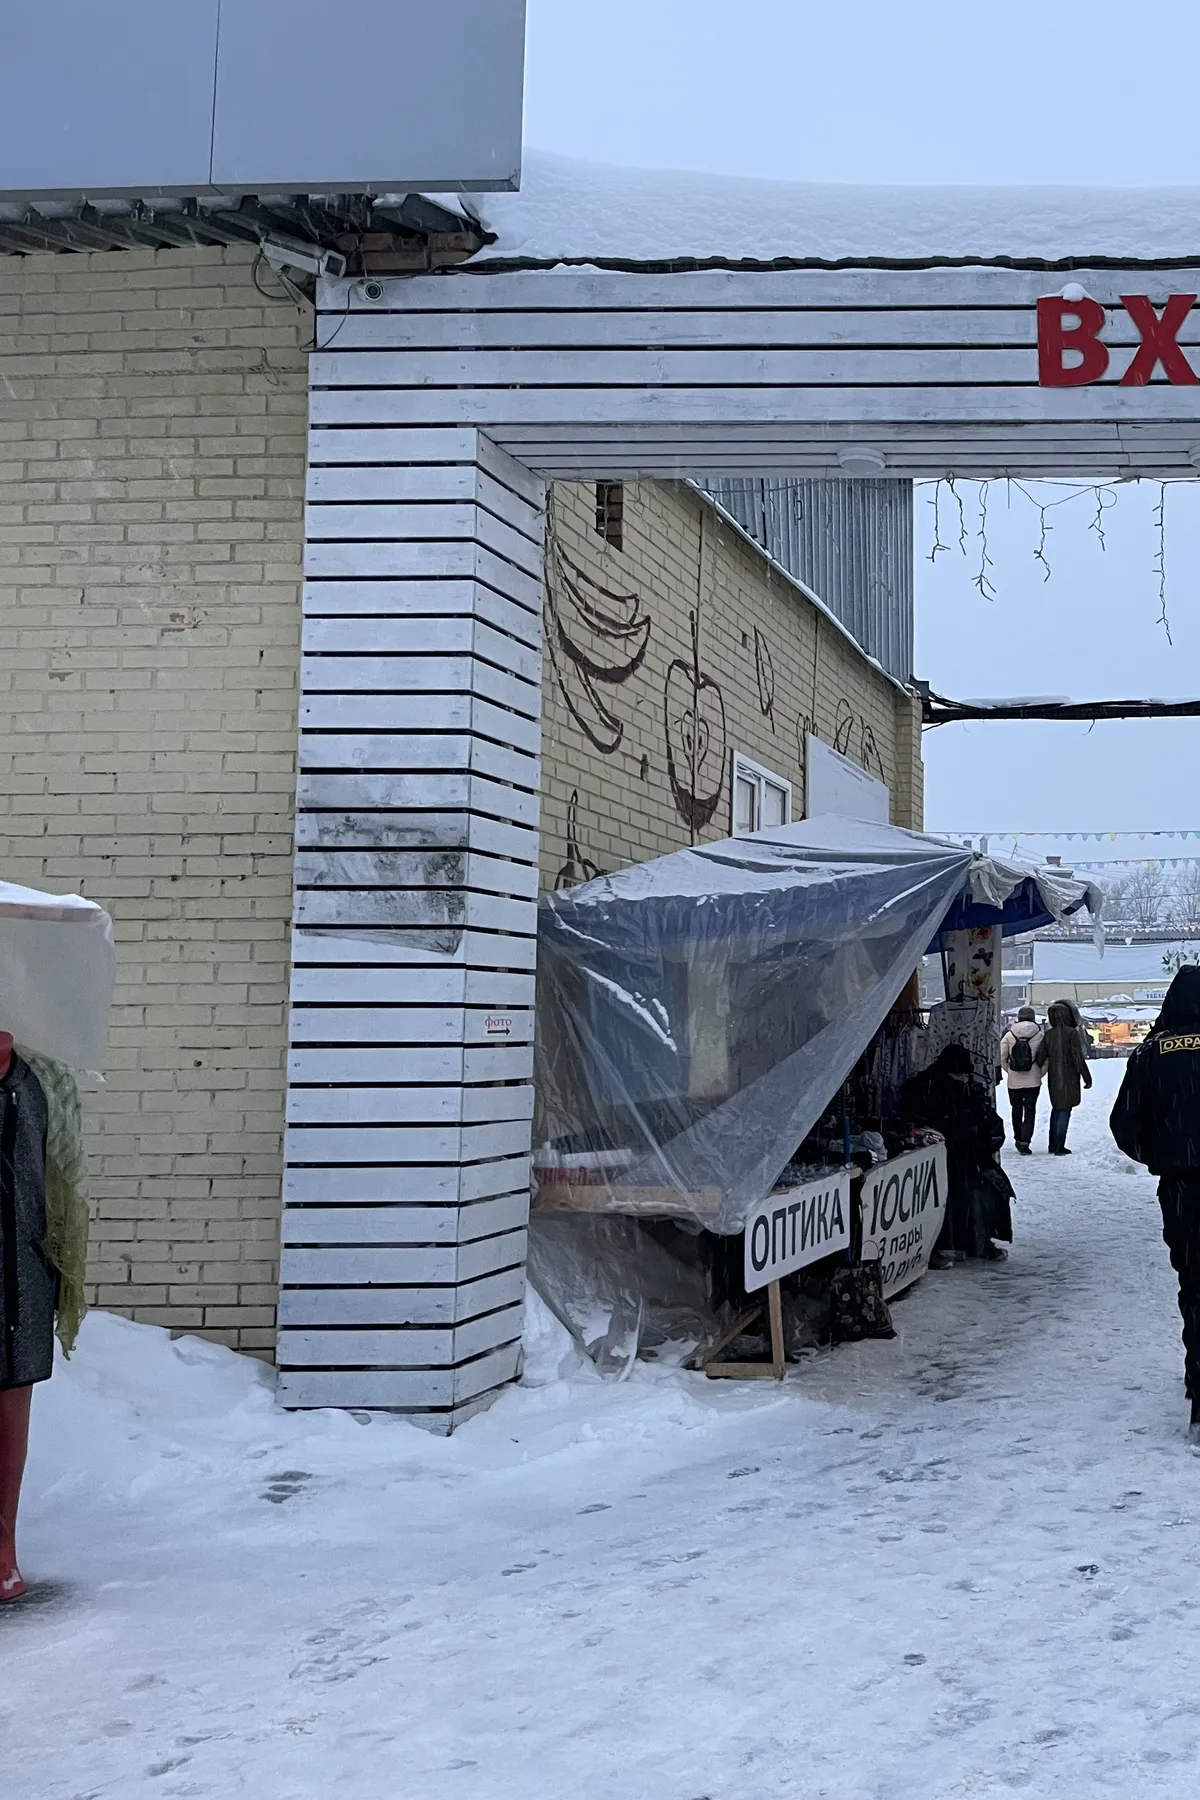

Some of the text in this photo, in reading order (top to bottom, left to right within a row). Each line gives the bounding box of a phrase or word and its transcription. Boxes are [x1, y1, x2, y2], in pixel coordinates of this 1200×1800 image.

[485, 1016, 512, 1029] фото
[751, 1188, 845, 1272] ОПТИКА
[889, 1224, 923, 1256] пары
